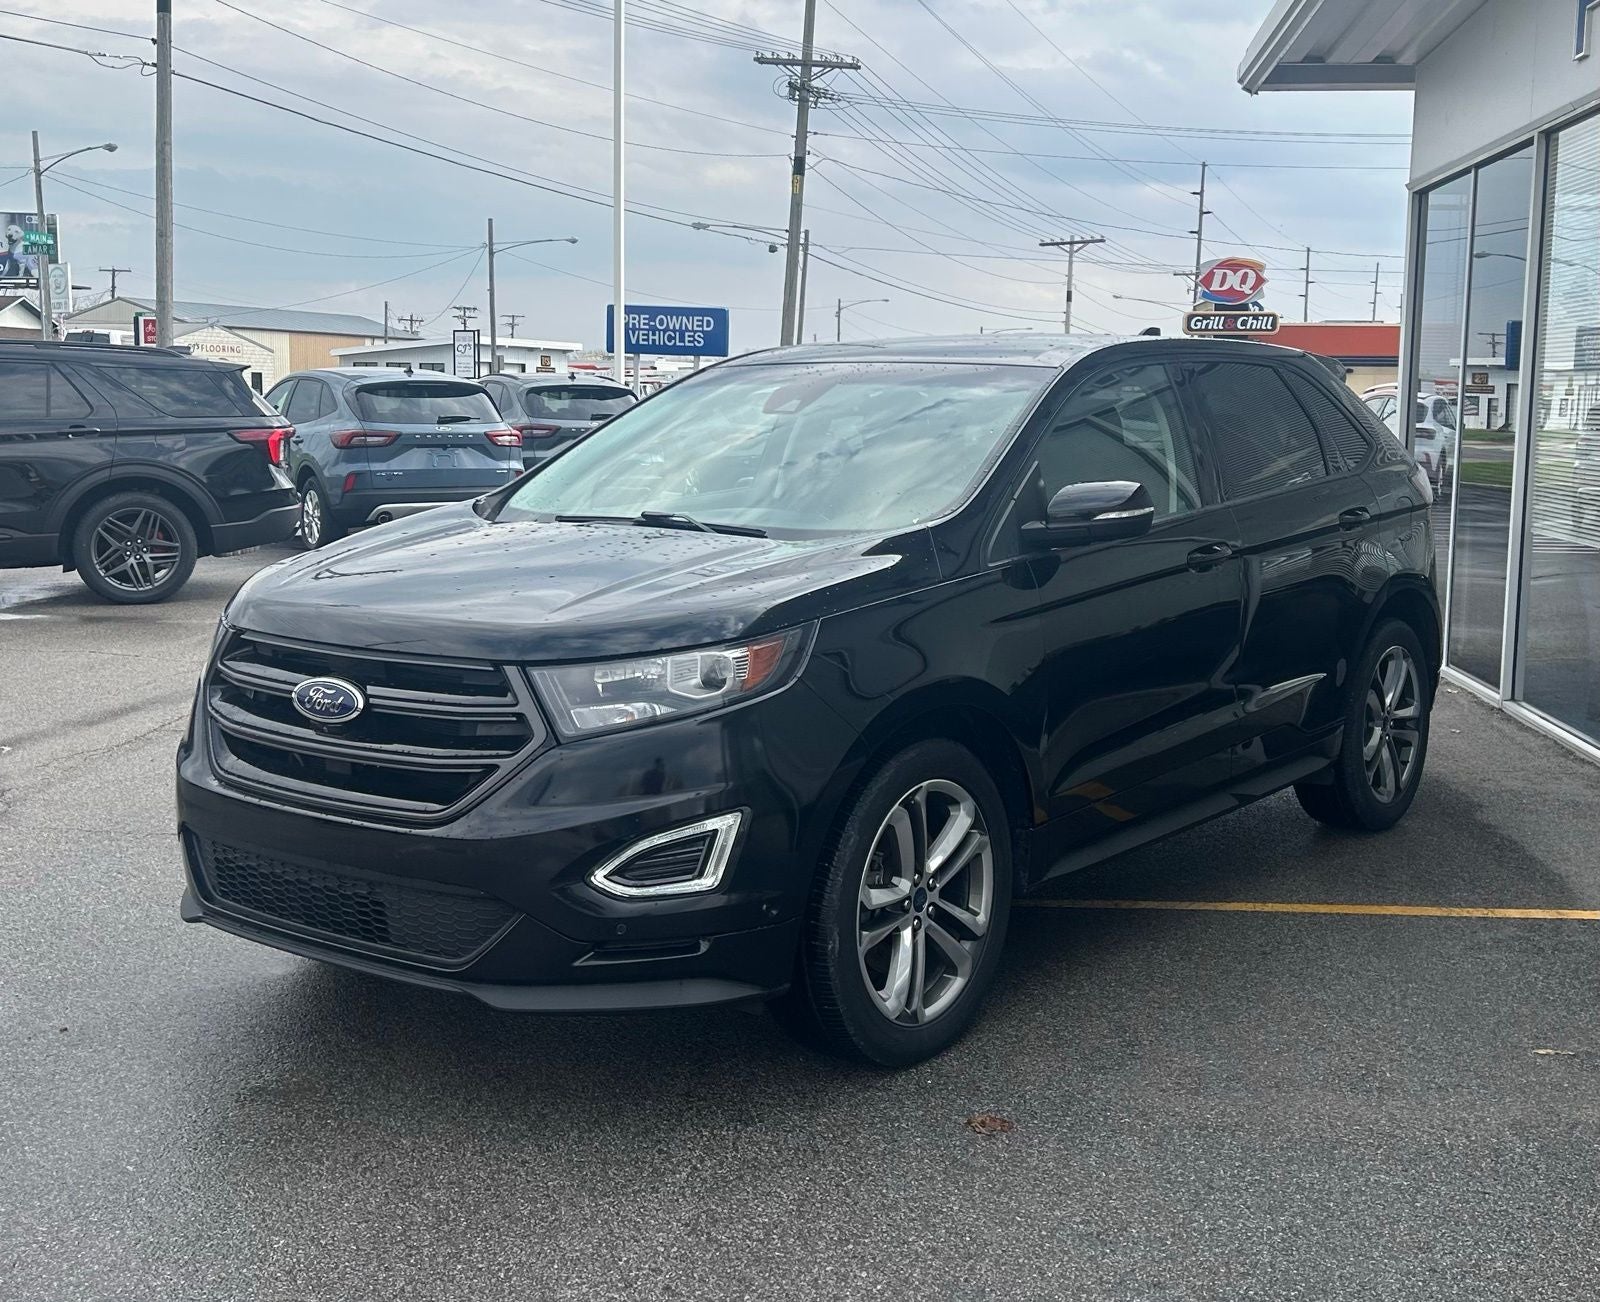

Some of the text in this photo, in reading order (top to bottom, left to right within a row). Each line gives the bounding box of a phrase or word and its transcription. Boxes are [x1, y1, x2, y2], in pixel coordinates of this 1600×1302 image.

[30, 233, 47, 242] MAIN
[1209, 268, 1257, 295] DQ
[1190, 316, 1274, 330] Grill & Chill
[628, 330, 705, 347] VEHICLES
[200, 343, 242, 354] FLOORING
[304, 686, 345, 713] Ford
